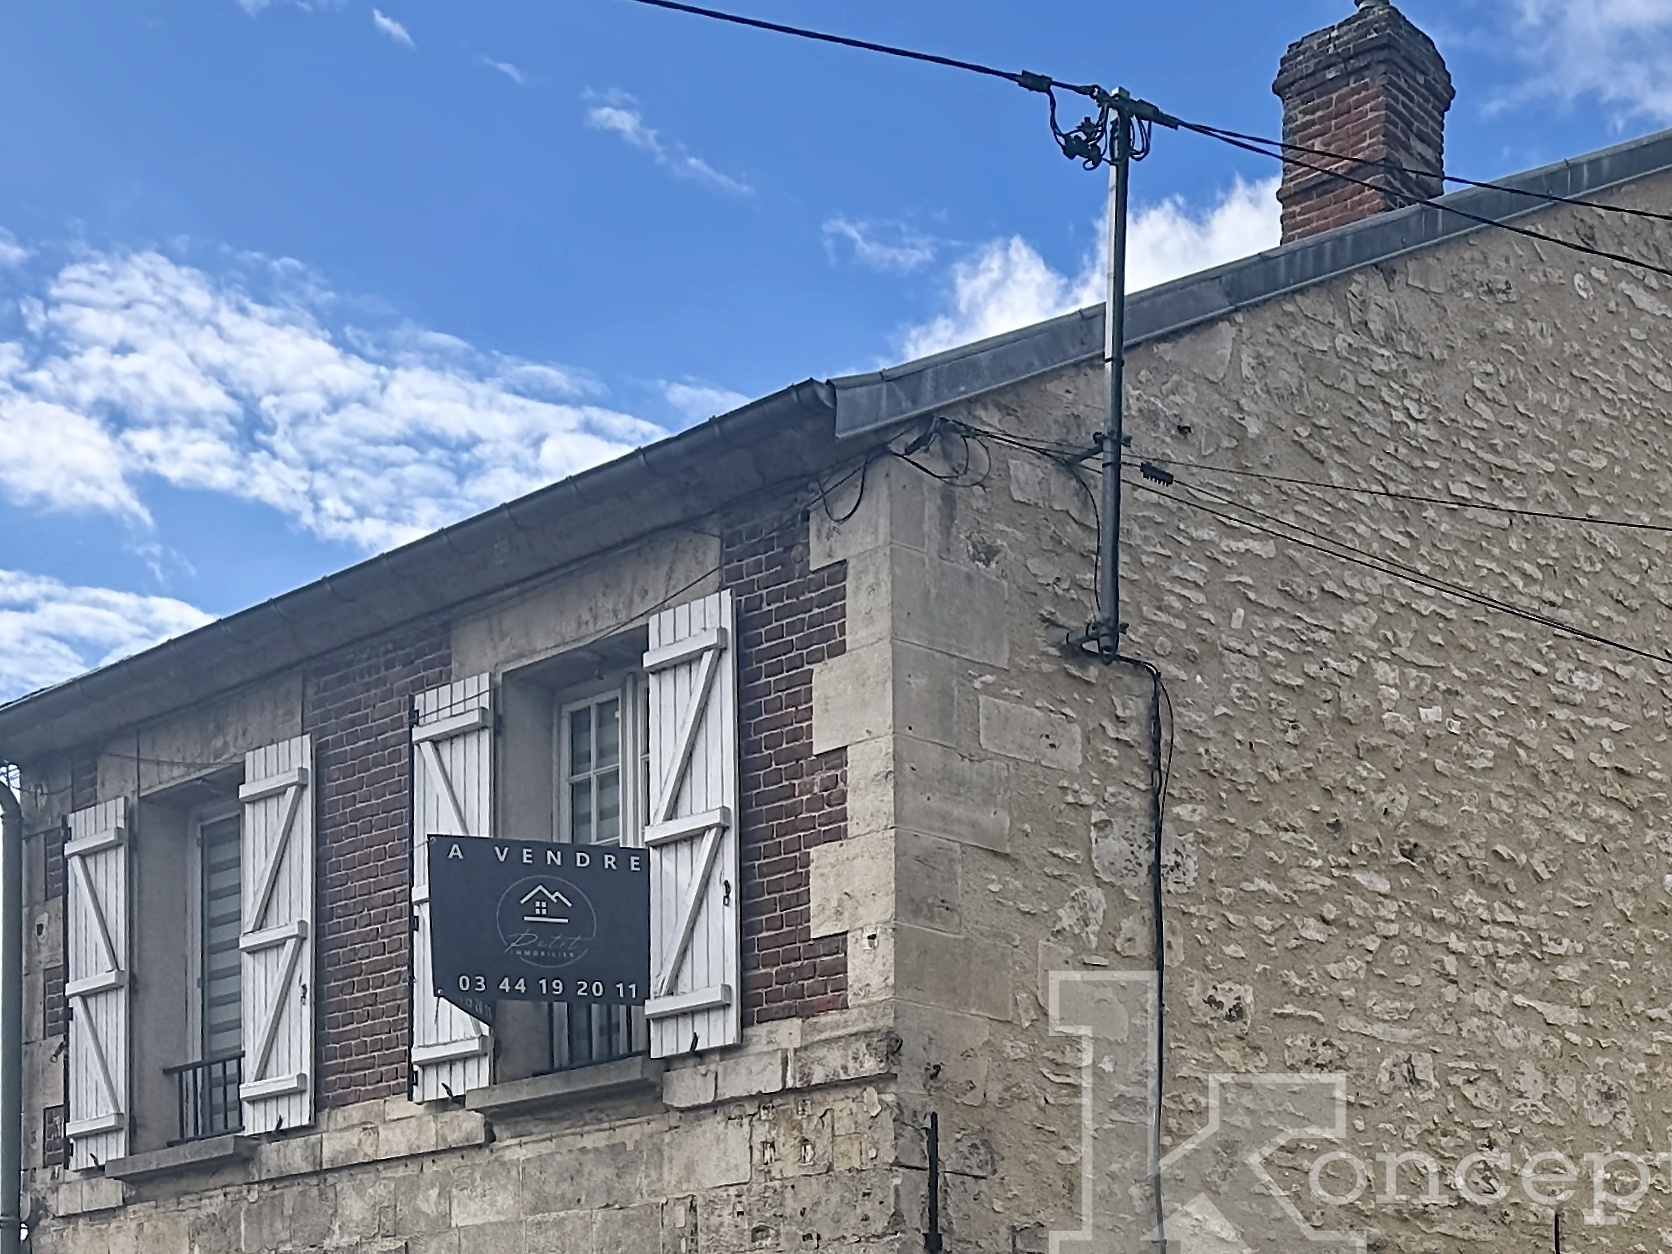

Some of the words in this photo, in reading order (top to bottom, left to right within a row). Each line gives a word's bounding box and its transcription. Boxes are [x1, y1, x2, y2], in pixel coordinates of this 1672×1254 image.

[448, 843, 464, 859] A
[494, 846, 641, 872] VENDRE
[459, 975, 486, 992] 03
[499, 977, 526, 994] 44
[538, 978, 564, 995] 19
[577, 981, 604, 998] 20
[616, 983, 638, 999] 11
